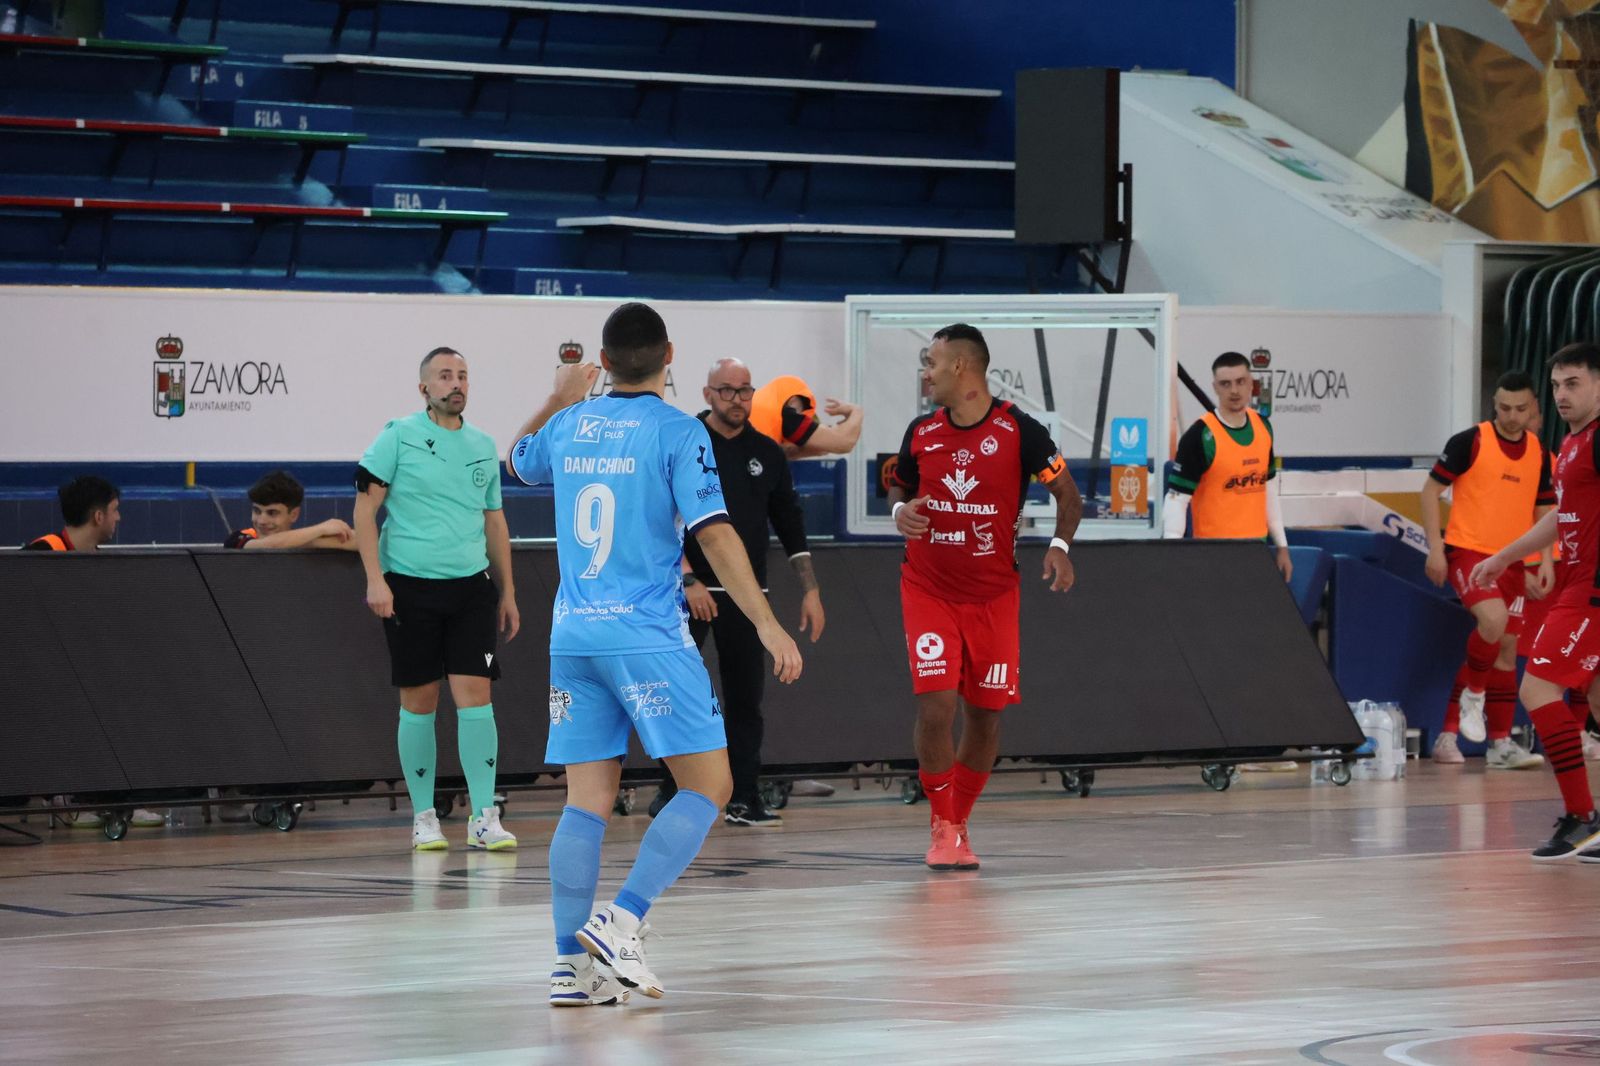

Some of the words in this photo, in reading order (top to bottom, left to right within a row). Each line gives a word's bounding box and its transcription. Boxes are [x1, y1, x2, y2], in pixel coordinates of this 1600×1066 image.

[189, 361, 289, 395] ZAMORA
[1275, 369, 1350, 399] ZAMORA
[188, 401, 252, 412] AYUNTAMIENTO
[604, 431, 625, 439] PLUS
[564, 456, 595, 473] DANI
[597, 456, 635, 474] CHINO
[927, 499, 953, 512] CAJA
[956, 503, 998, 515] RURAL
[574, 483, 615, 579] 9
[609, 603, 634, 613] salud
[919, 668, 946, 677] Zamora
